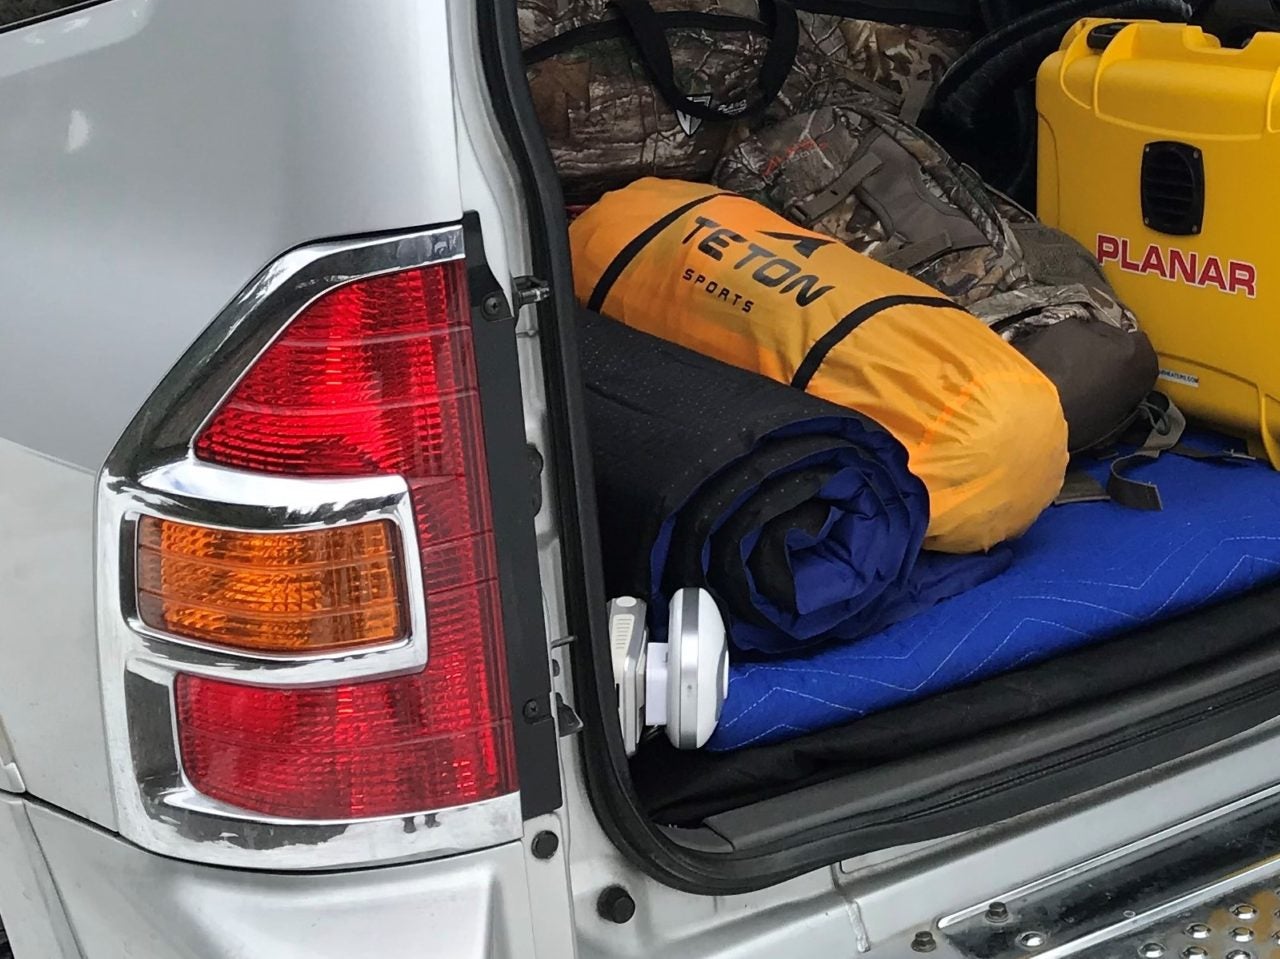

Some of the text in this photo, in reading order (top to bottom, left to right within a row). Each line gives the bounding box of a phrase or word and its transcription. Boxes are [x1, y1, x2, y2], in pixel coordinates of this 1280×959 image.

[682, 216, 836, 307] TETON
[682, 268, 755, 313] SPORTS
[1097, 234, 1256, 298] PLANAR
